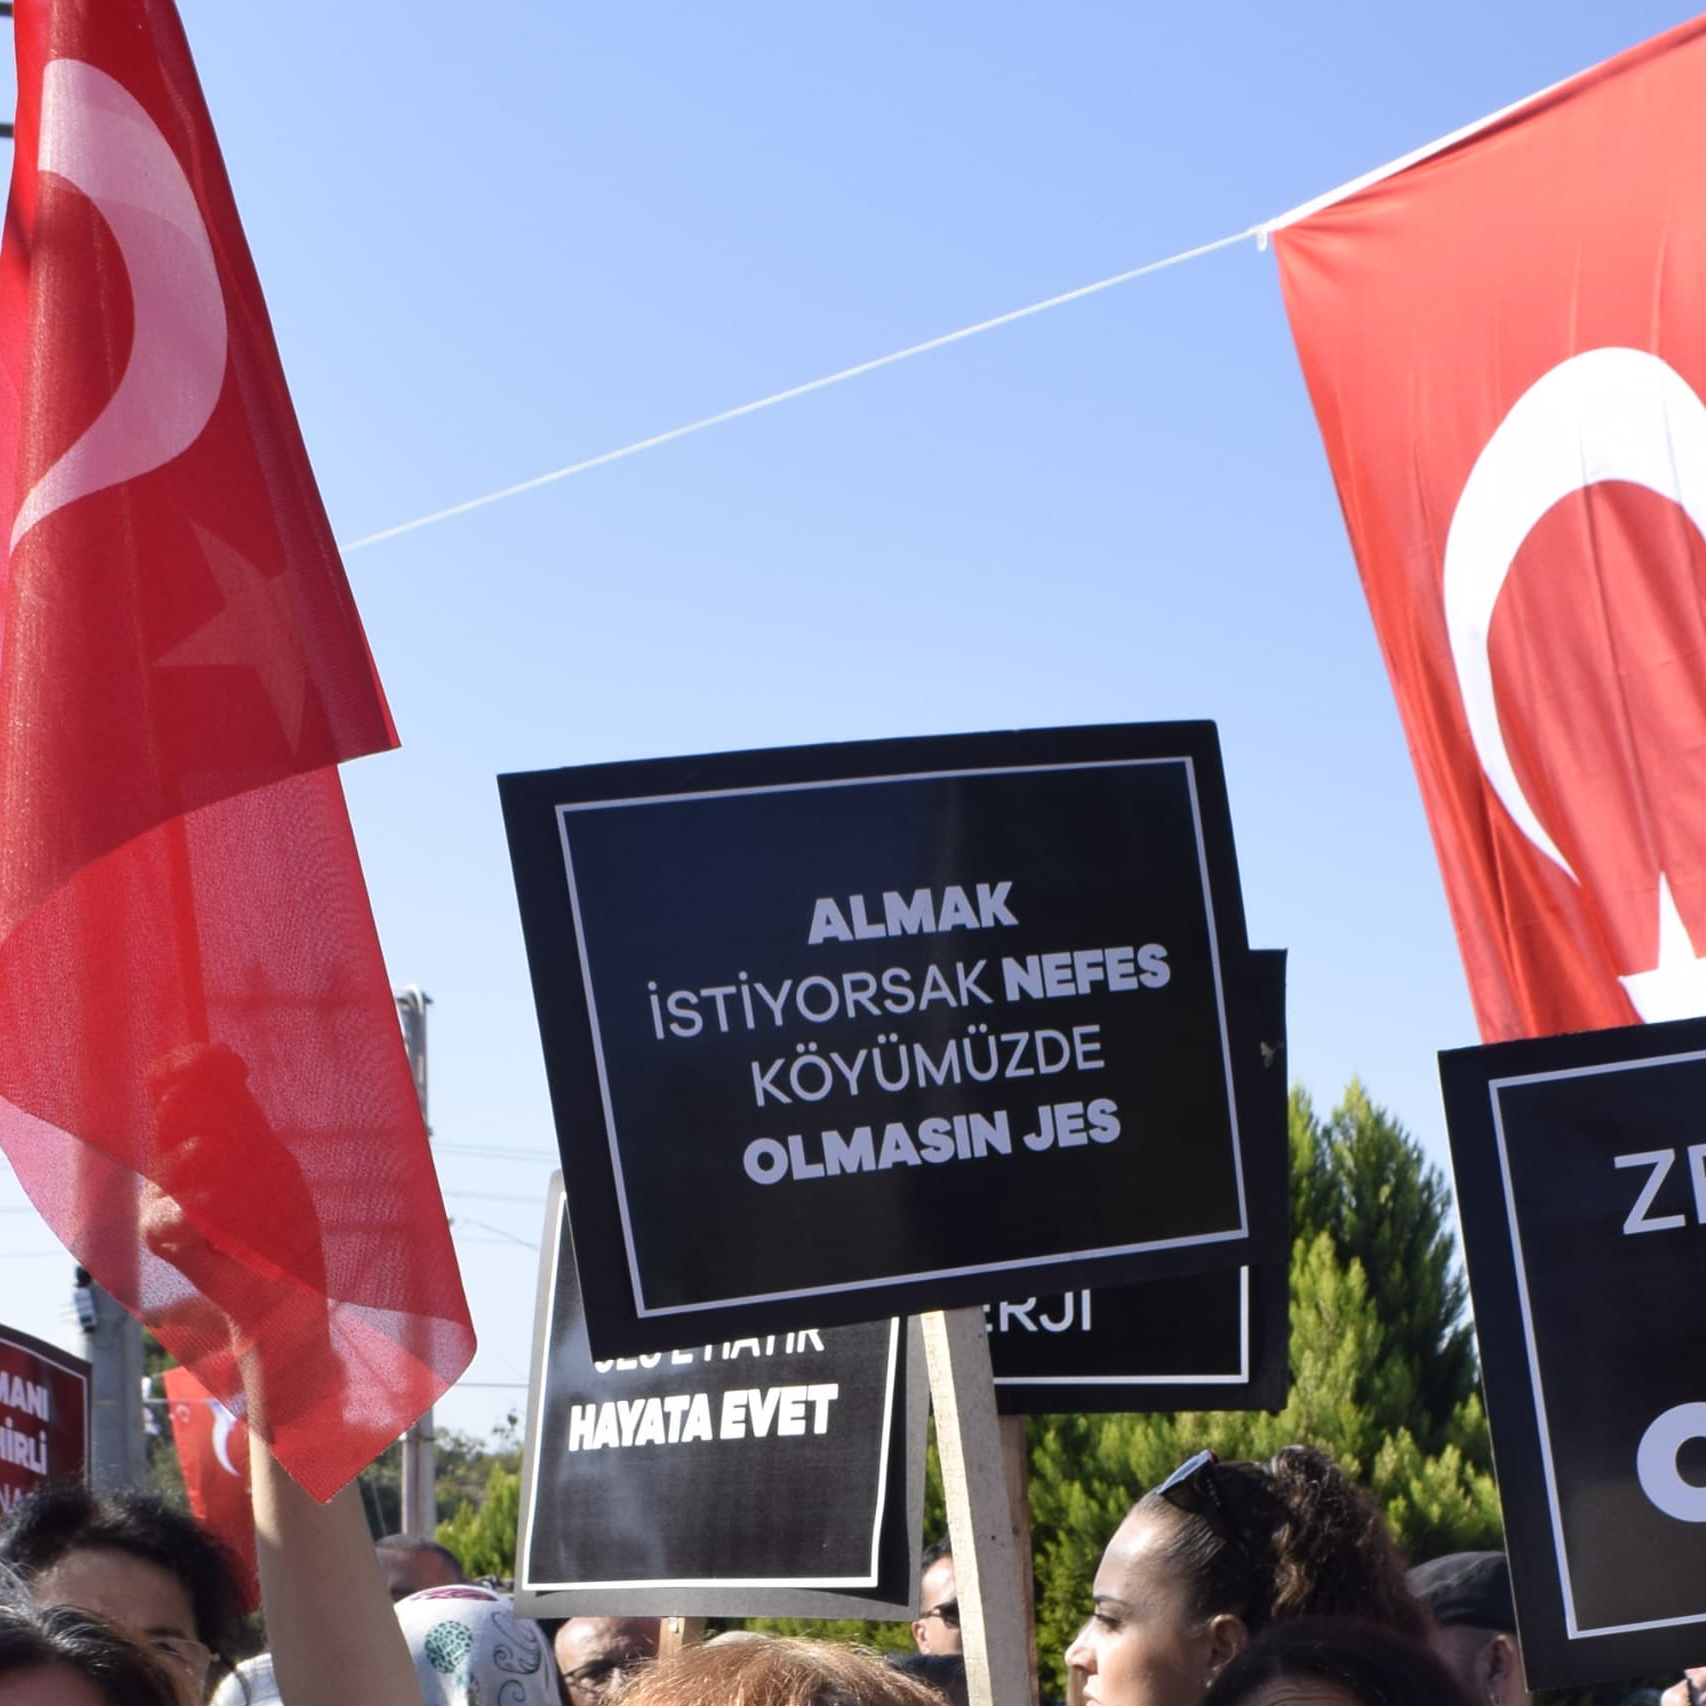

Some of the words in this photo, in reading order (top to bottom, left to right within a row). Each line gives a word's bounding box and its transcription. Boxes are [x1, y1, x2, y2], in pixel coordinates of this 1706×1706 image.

[807, 880, 1021, 946] ALMAK
[645, 960, 995, 1041] İSTİYORSAK
[1002, 942, 1172, 1004] NEFES
[750, 1024, 1106, 1107] KÖYÜMÜZDE
[742, 1110, 1014, 1187] OLMASIN
[1022, 1098, 1123, 1153] JES
[568, 1393, 713, 1451] HAYATA
[719, 1383, 839, 1440] EVET
